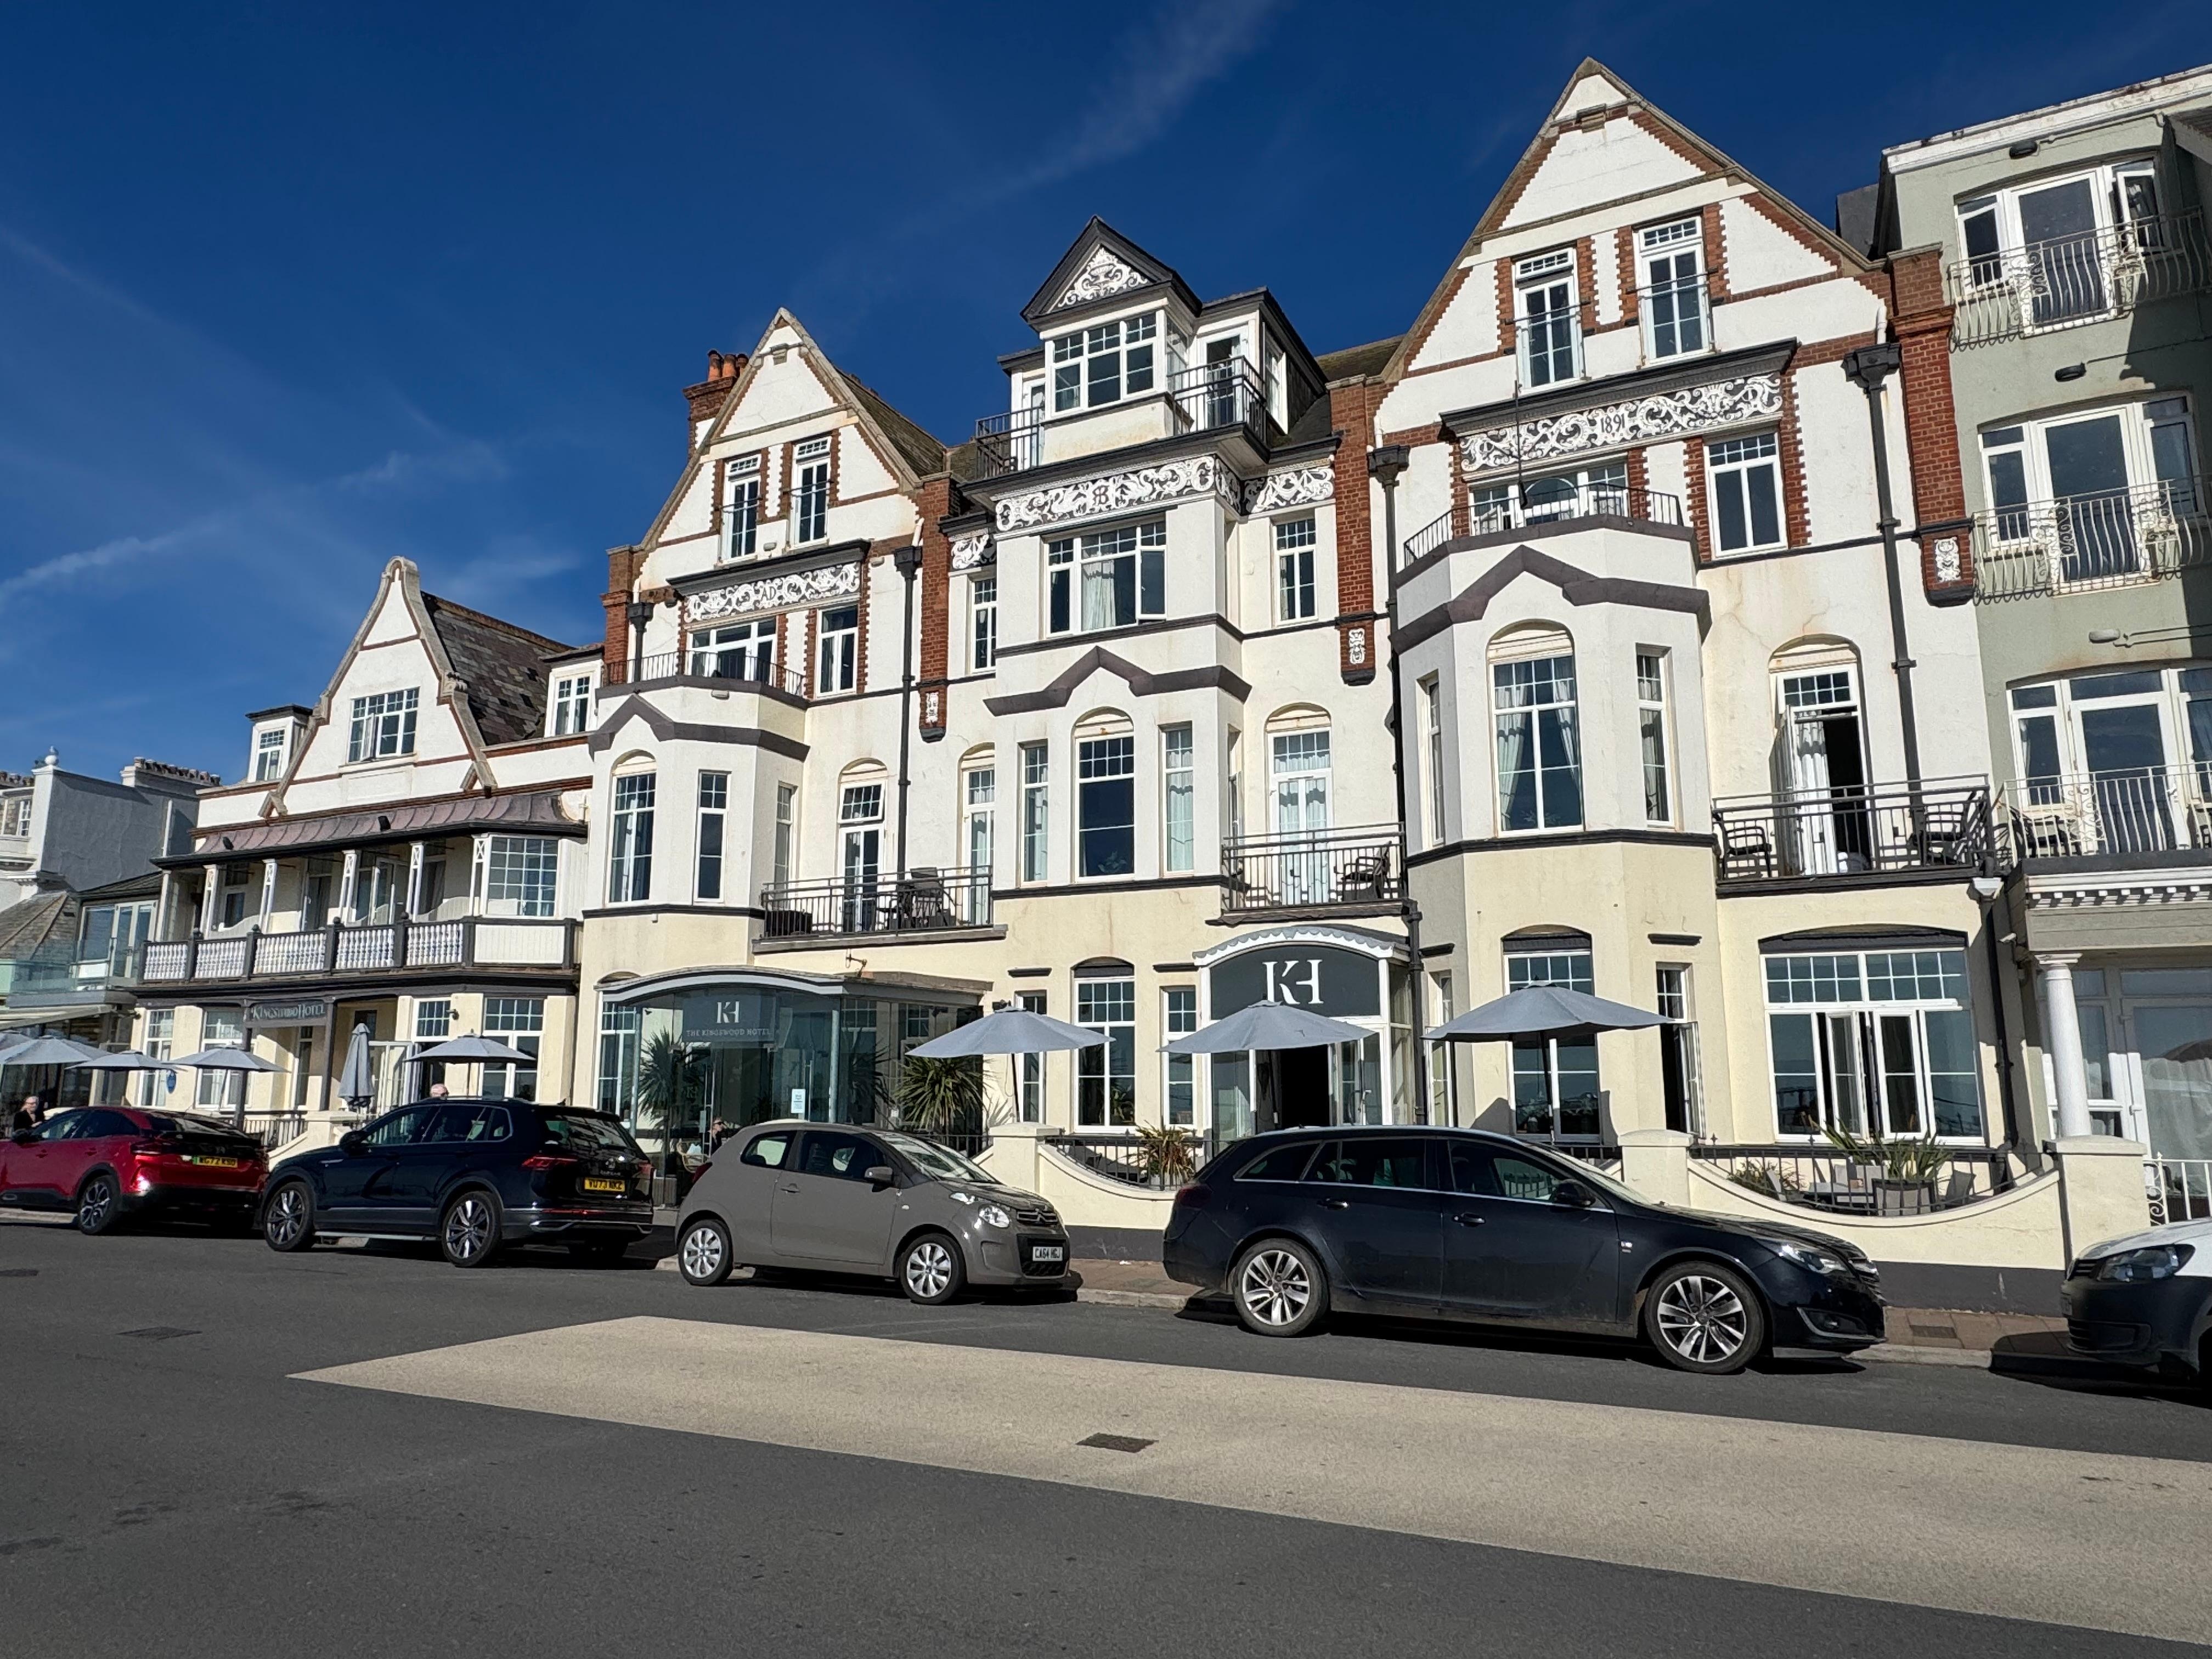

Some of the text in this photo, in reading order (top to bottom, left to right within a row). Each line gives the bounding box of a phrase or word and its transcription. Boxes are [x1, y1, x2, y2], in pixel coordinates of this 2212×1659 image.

[1262, 959, 1324, 1005] KH
[716, 1001, 740, 1024] KH
[746, 1028, 772, 1036] HOTEL
